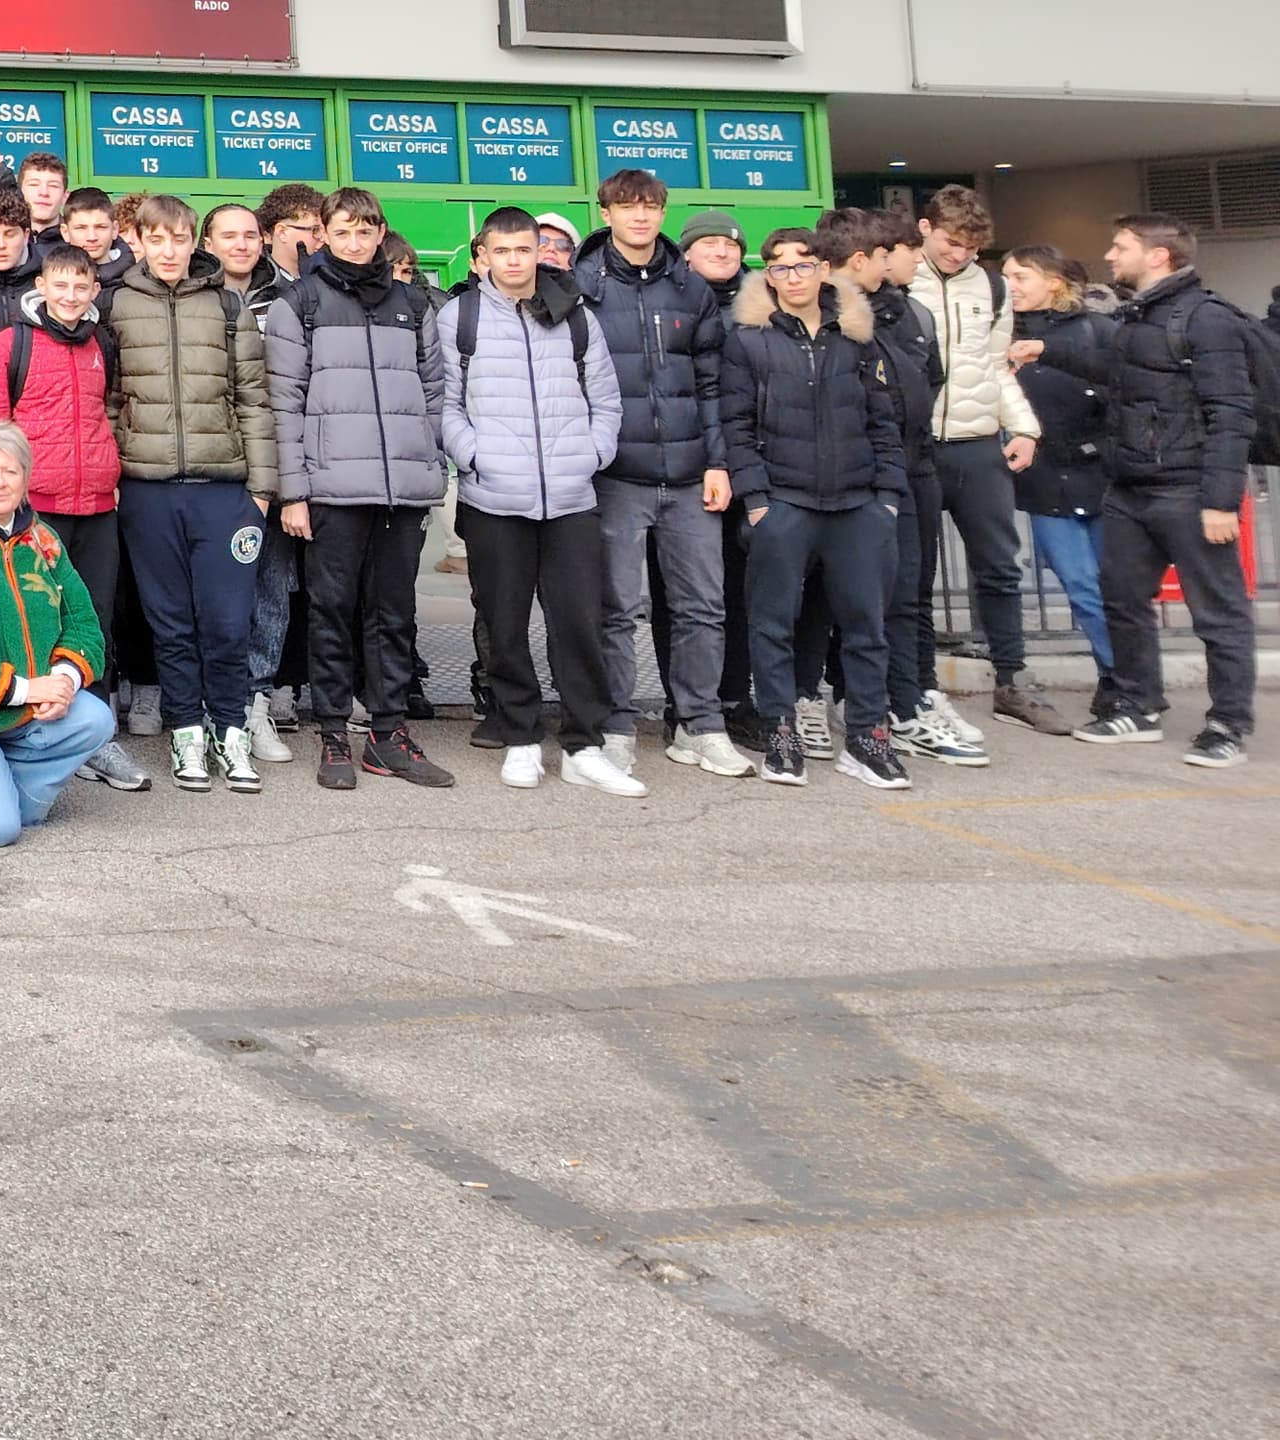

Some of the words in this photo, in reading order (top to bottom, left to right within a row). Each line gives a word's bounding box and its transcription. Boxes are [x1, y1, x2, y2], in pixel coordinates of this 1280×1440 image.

[195, 0, 230, 11] RADIO
[112, 107, 183, 126] CASSA
[231, 110, 301, 129] CASSA
[369, 114, 437, 133] CASSA
[481, 117, 549, 136] CASSA
[613, 120, 678, 139] CASSA
[719, 123, 784, 141] CASSA
[6, 132, 52, 144] OFFICE
[104, 134, 147, 146] TICKET
[150, 135, 194, 147] OFFICE
[223, 137, 265, 149] TICKET
[268, 138, 311, 151] OFFICE
[361, 141, 401, 153] TICKET
[405, 142, 448, 154] OFFICE
[474, 143, 515, 156] TICKET
[517, 144, 559, 157] OFFICE
[605, 146, 644, 158] TICKET
[647, 147, 688, 159] OFFICE
[712, 149, 751, 161] TICKET
[753, 150, 793, 161] OFFICE
[141, 158, 159, 173] 13
[259, 161, 278, 176] 14
[397, 164, 414, 179] 15
[510, 167, 527, 182] 16
[745, 171, 763, 186] 18
